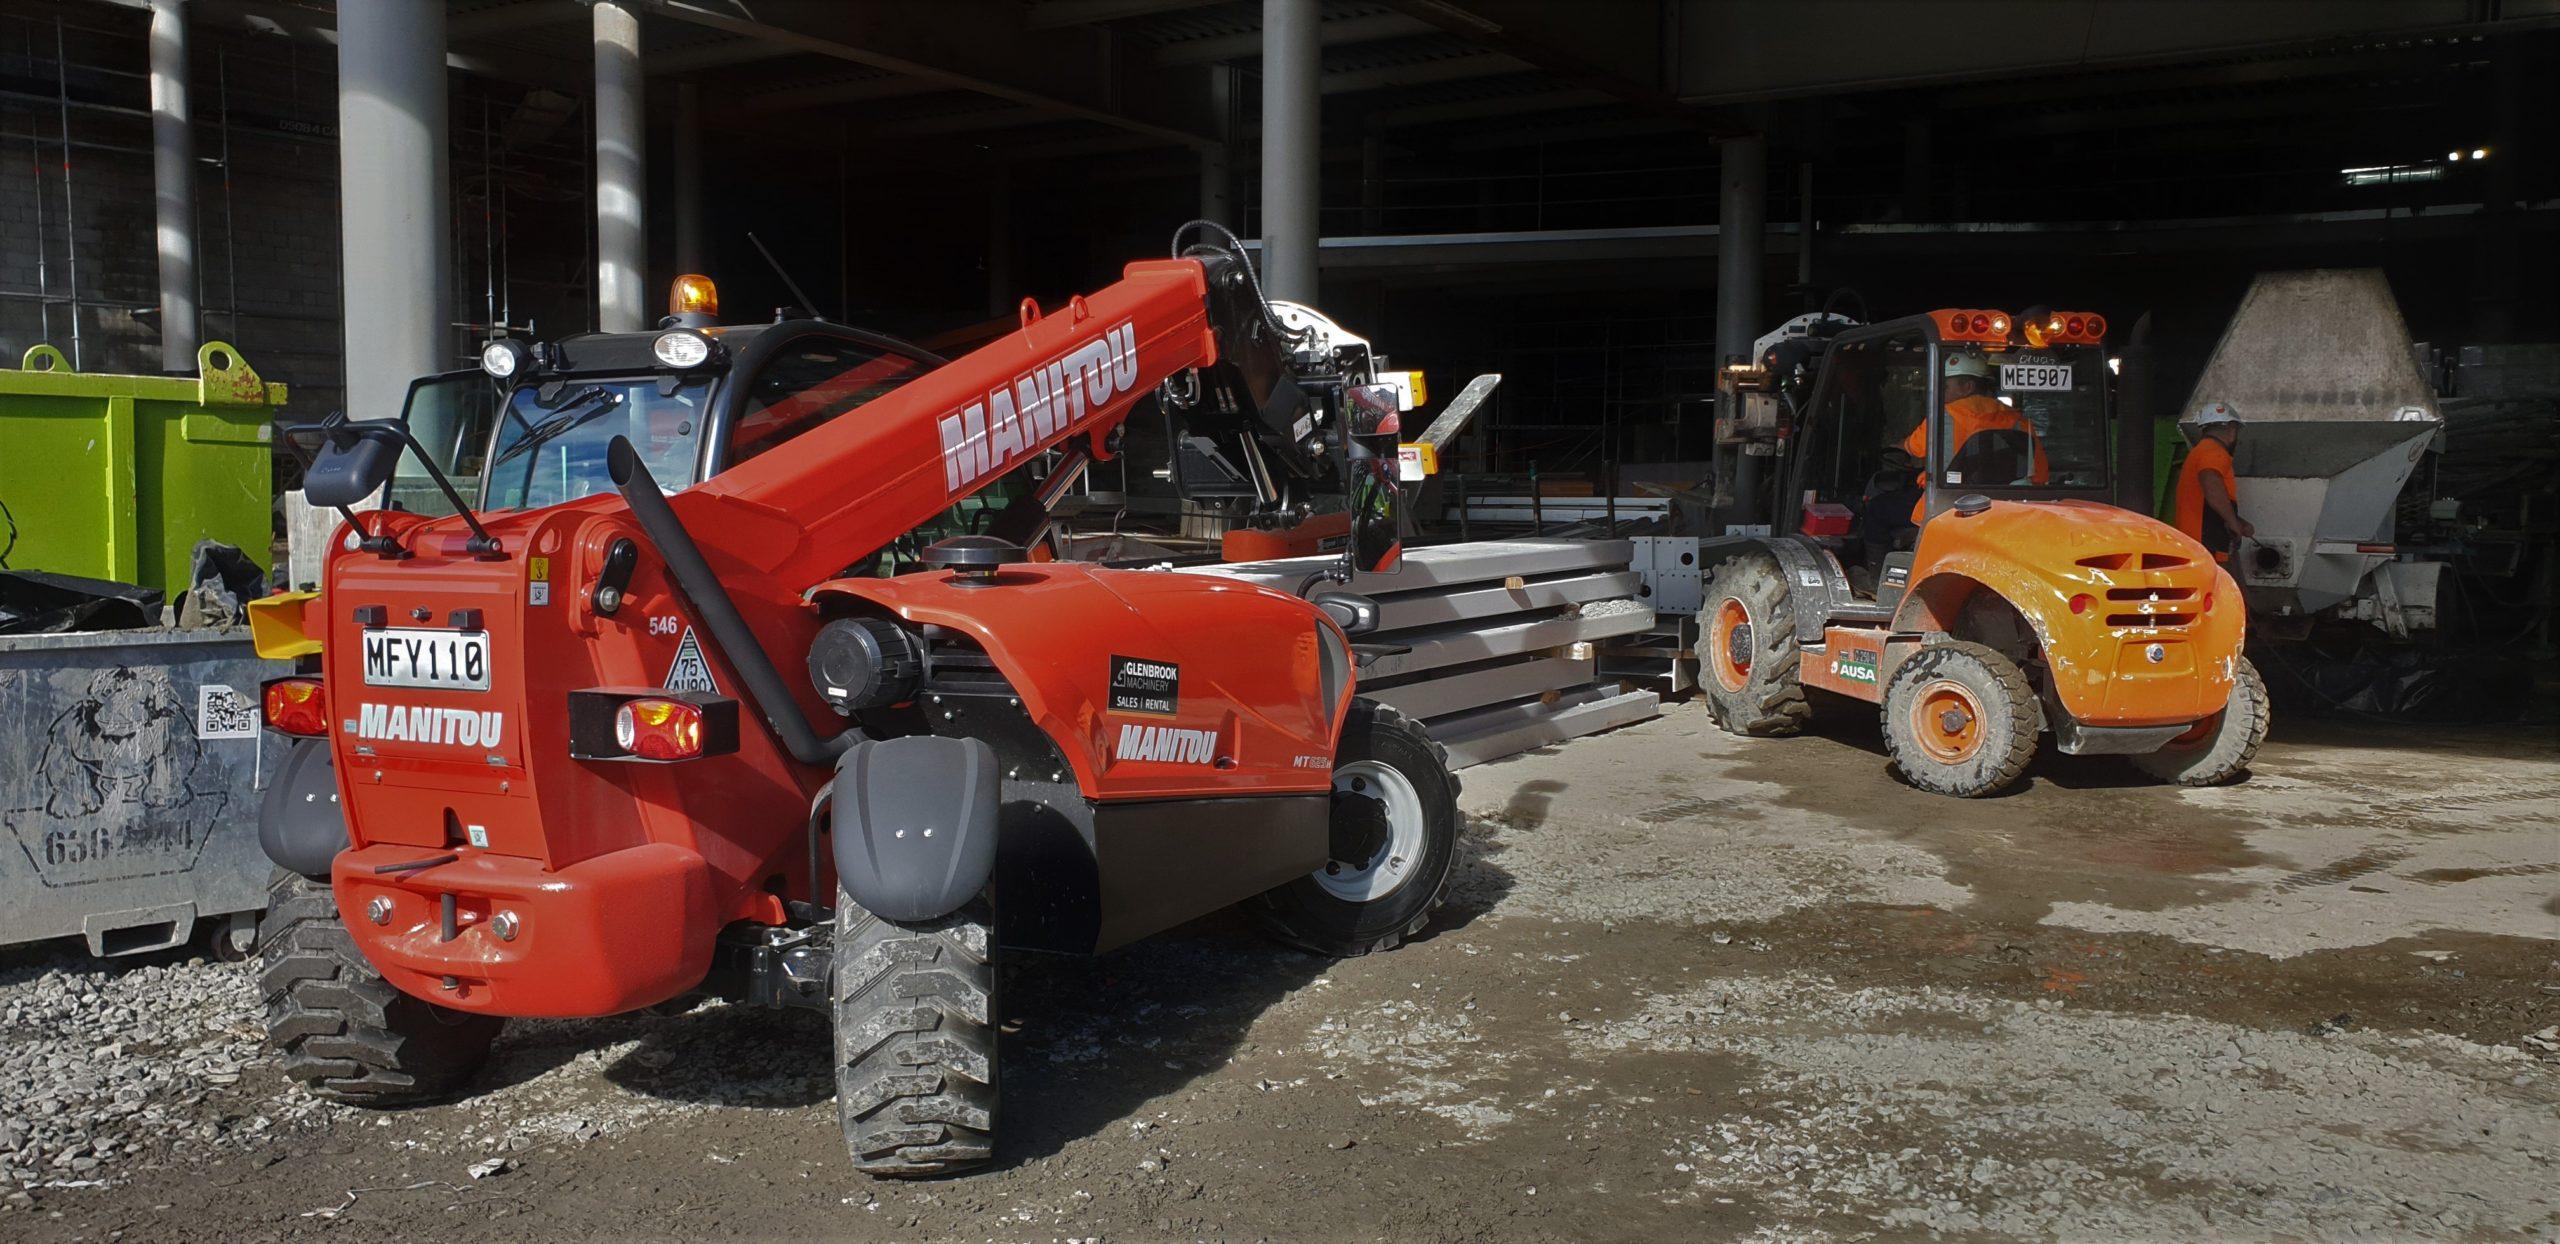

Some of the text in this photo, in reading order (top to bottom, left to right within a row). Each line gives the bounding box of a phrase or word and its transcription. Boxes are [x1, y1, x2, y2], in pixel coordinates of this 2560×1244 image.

[2004, 367, 2069, 387] MEE907
[940, 321, 1138, 493] MANITOU
[649, 616, 678, 635] 546
[366, 637, 483, 682] MFY110
[681, 657, 698, 678] 75
[1126, 661, 1177, 680] GLENBROOK
[1840, 664, 1876, 681] AUSA
[1126, 676, 1169, 692] MACHINERY
[1117, 696, 1170, 711] SALES RENTAL
[358, 703, 503, 748] MANITOU
[1116, 724, 1218, 764] MANITOU
